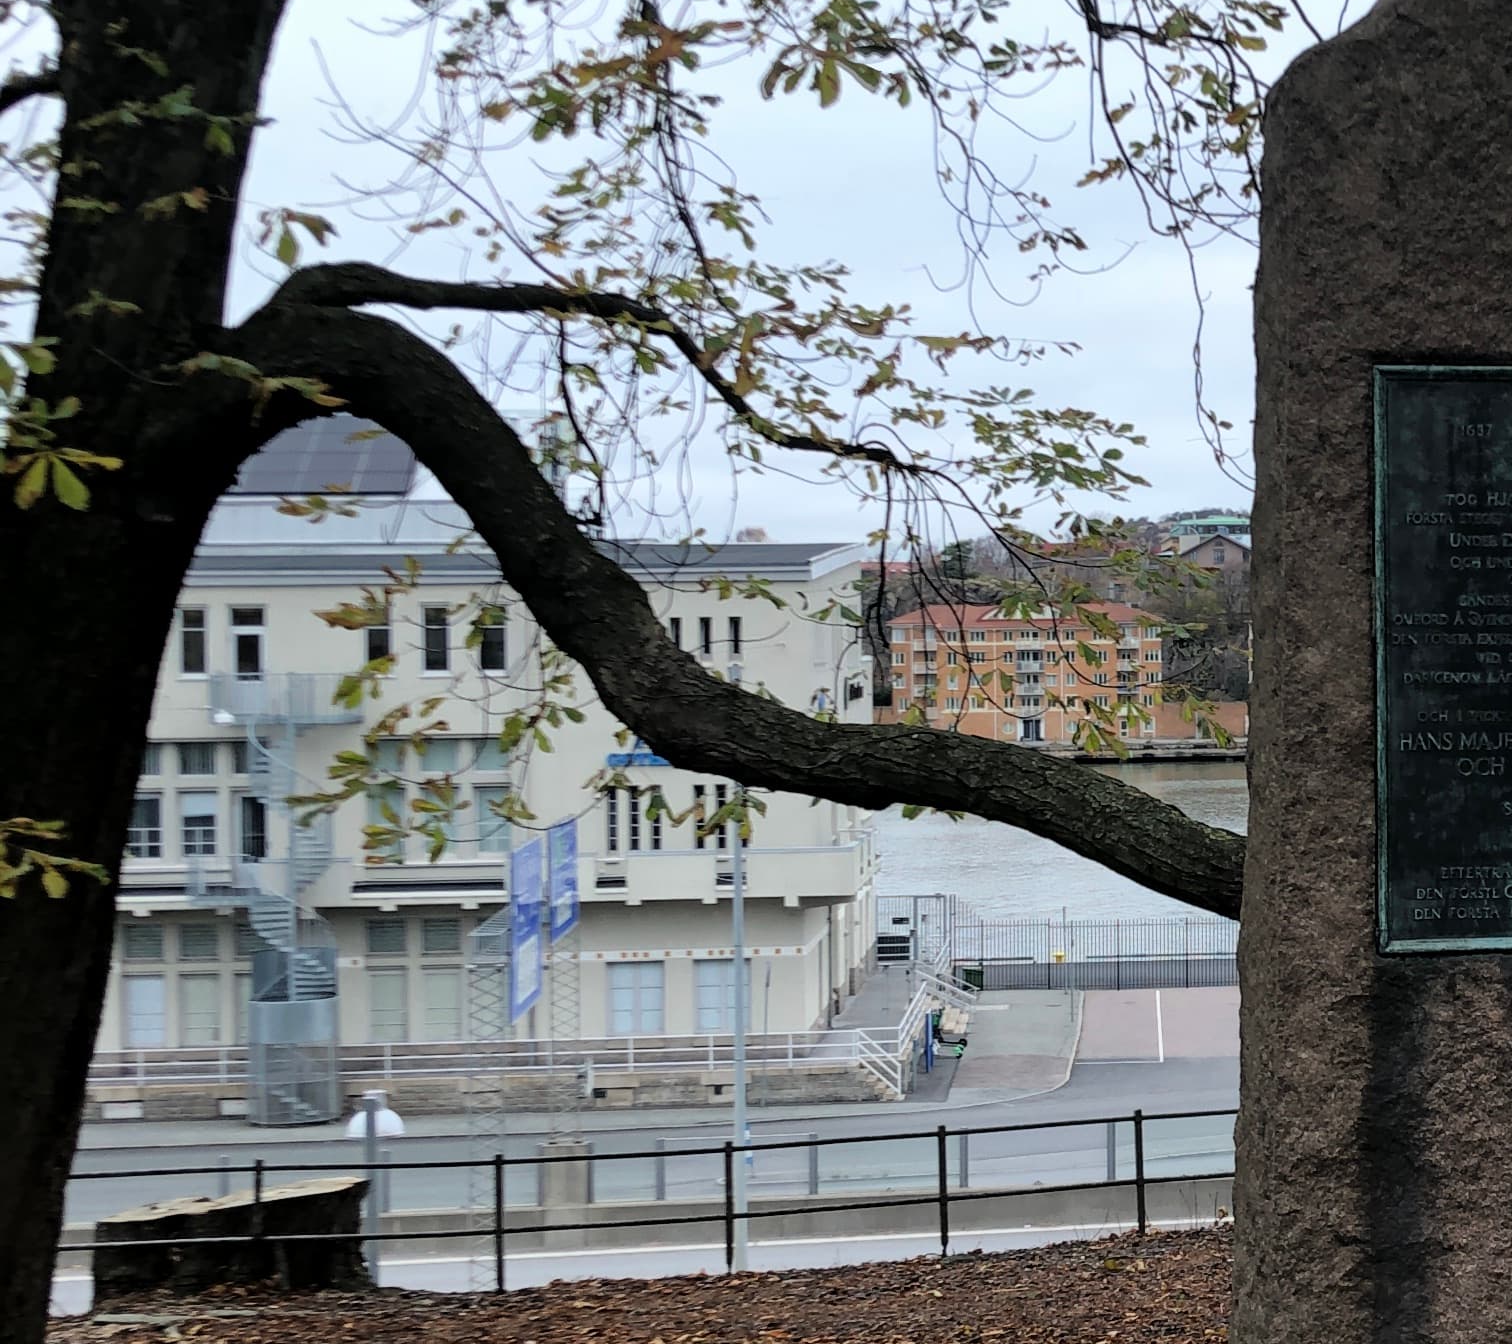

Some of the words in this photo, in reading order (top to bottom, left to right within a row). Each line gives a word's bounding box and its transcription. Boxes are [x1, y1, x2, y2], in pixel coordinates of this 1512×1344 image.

[1445, 492, 1478, 506] TOG
[1449, 532, 1498, 548] UNDER
[1449, 555, 1482, 569] OCH
[1417, 709, 1449, 722] OCH
[1399, 732, 1454, 752] HANS
[1456, 757, 1505, 777] OCH
[1416, 887, 1444, 900] DEN
